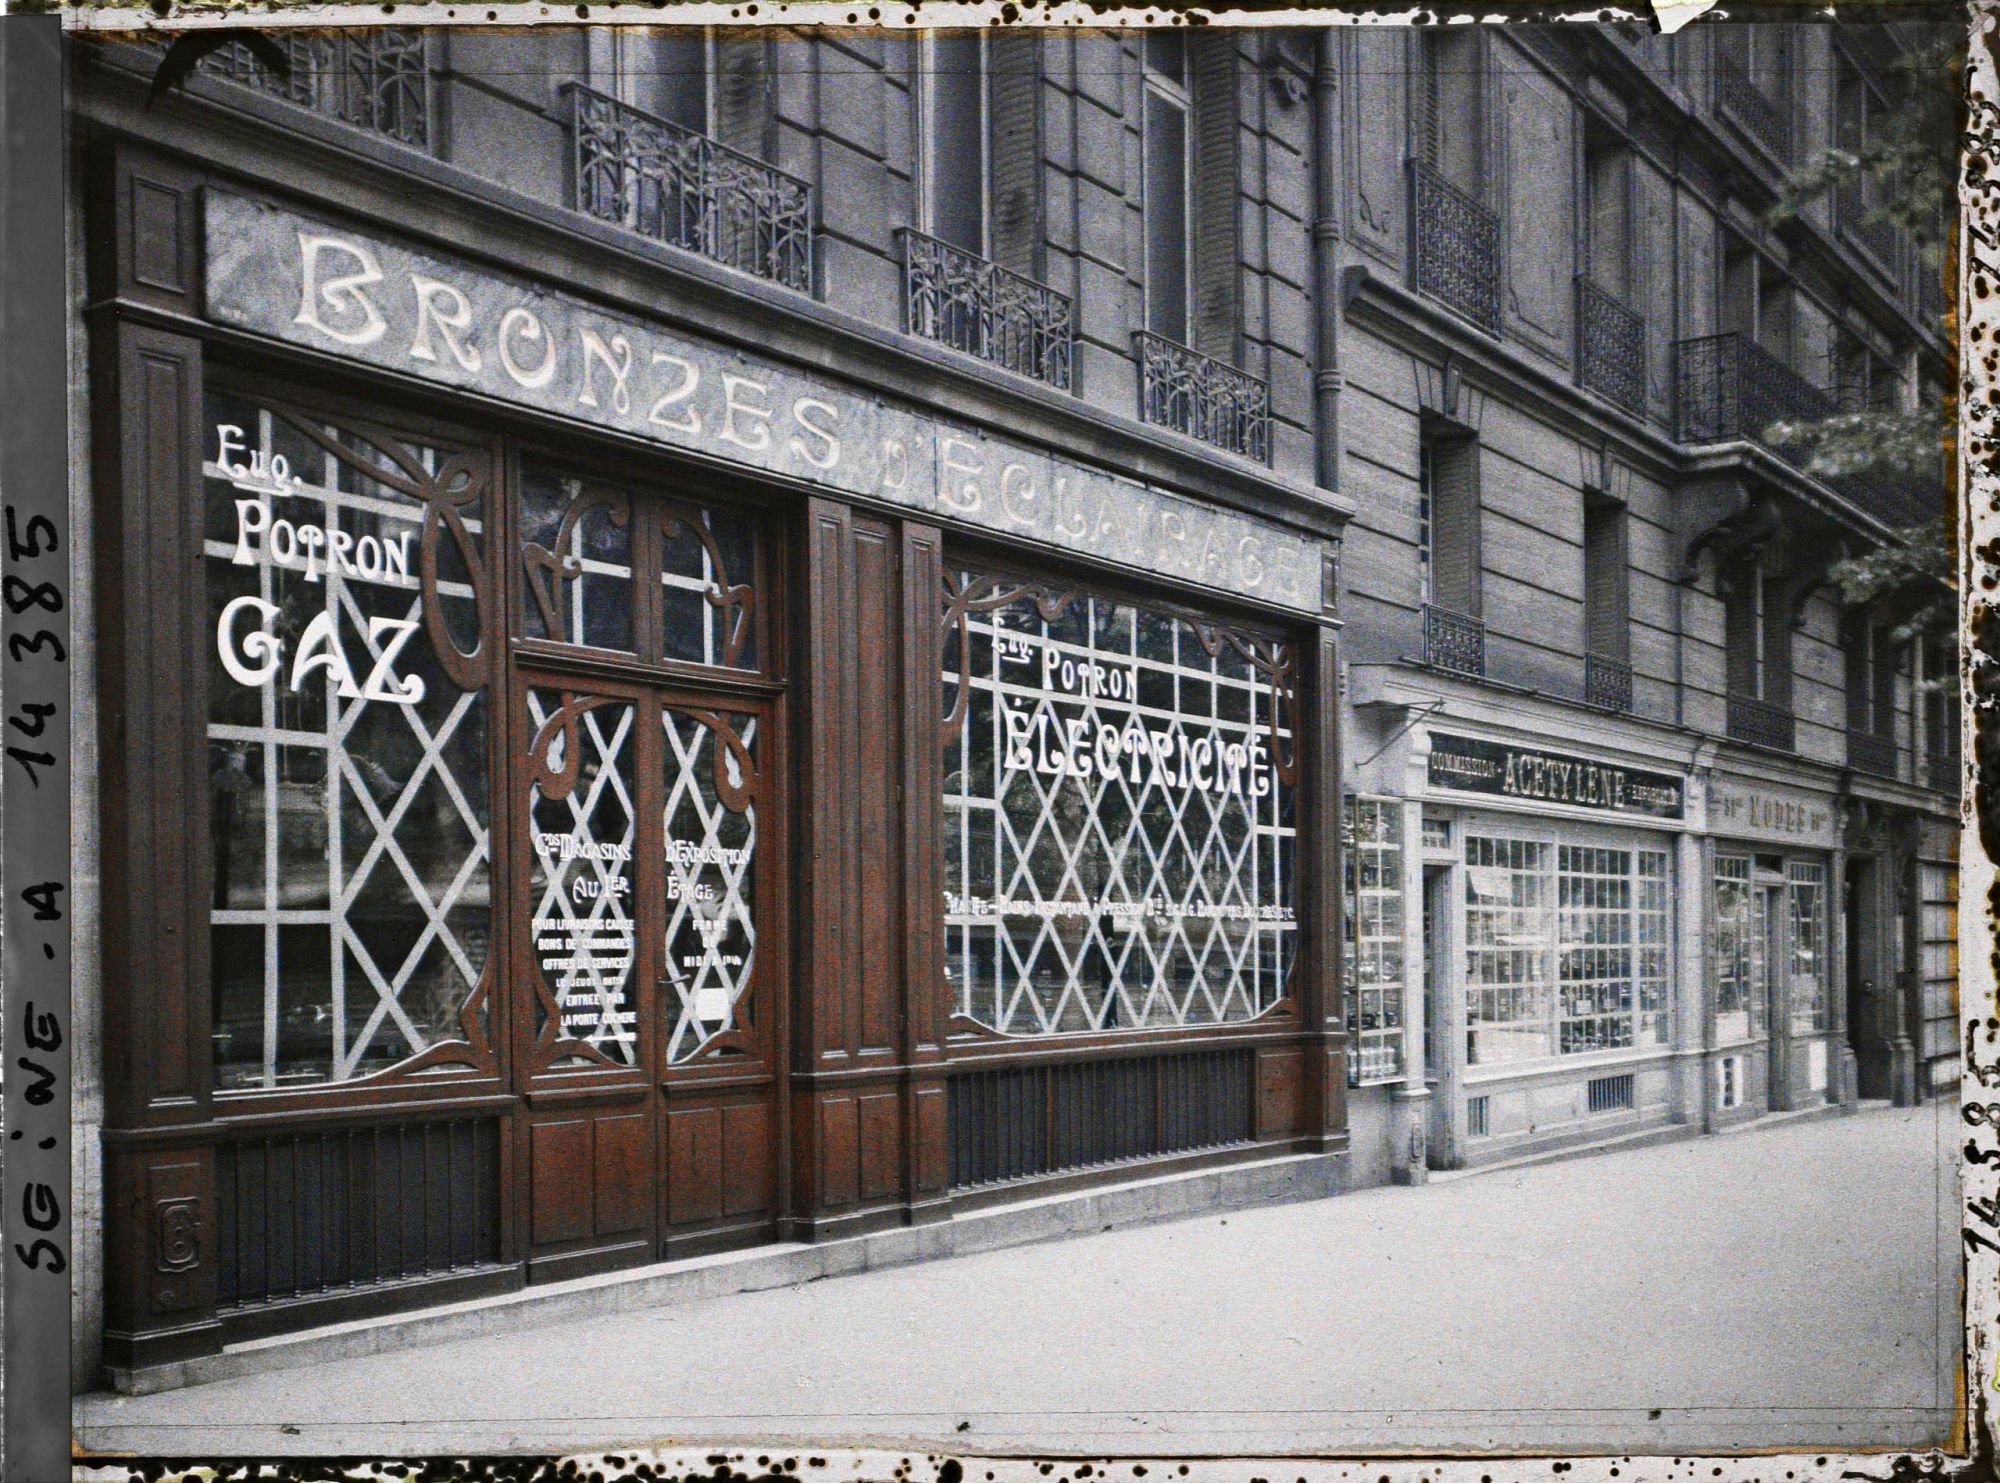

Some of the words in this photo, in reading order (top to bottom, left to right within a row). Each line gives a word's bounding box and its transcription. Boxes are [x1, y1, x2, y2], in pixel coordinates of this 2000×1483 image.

[293, 233, 840, 468] BRONZES
[232, 499, 412, 585] POTRON
[217, 596, 427, 704] GAZ
[1043, 648, 1137, 699] POTRON
[1431, 751, 1496, 778] COMMISSION
[538, 938, 563, 950] BONS
